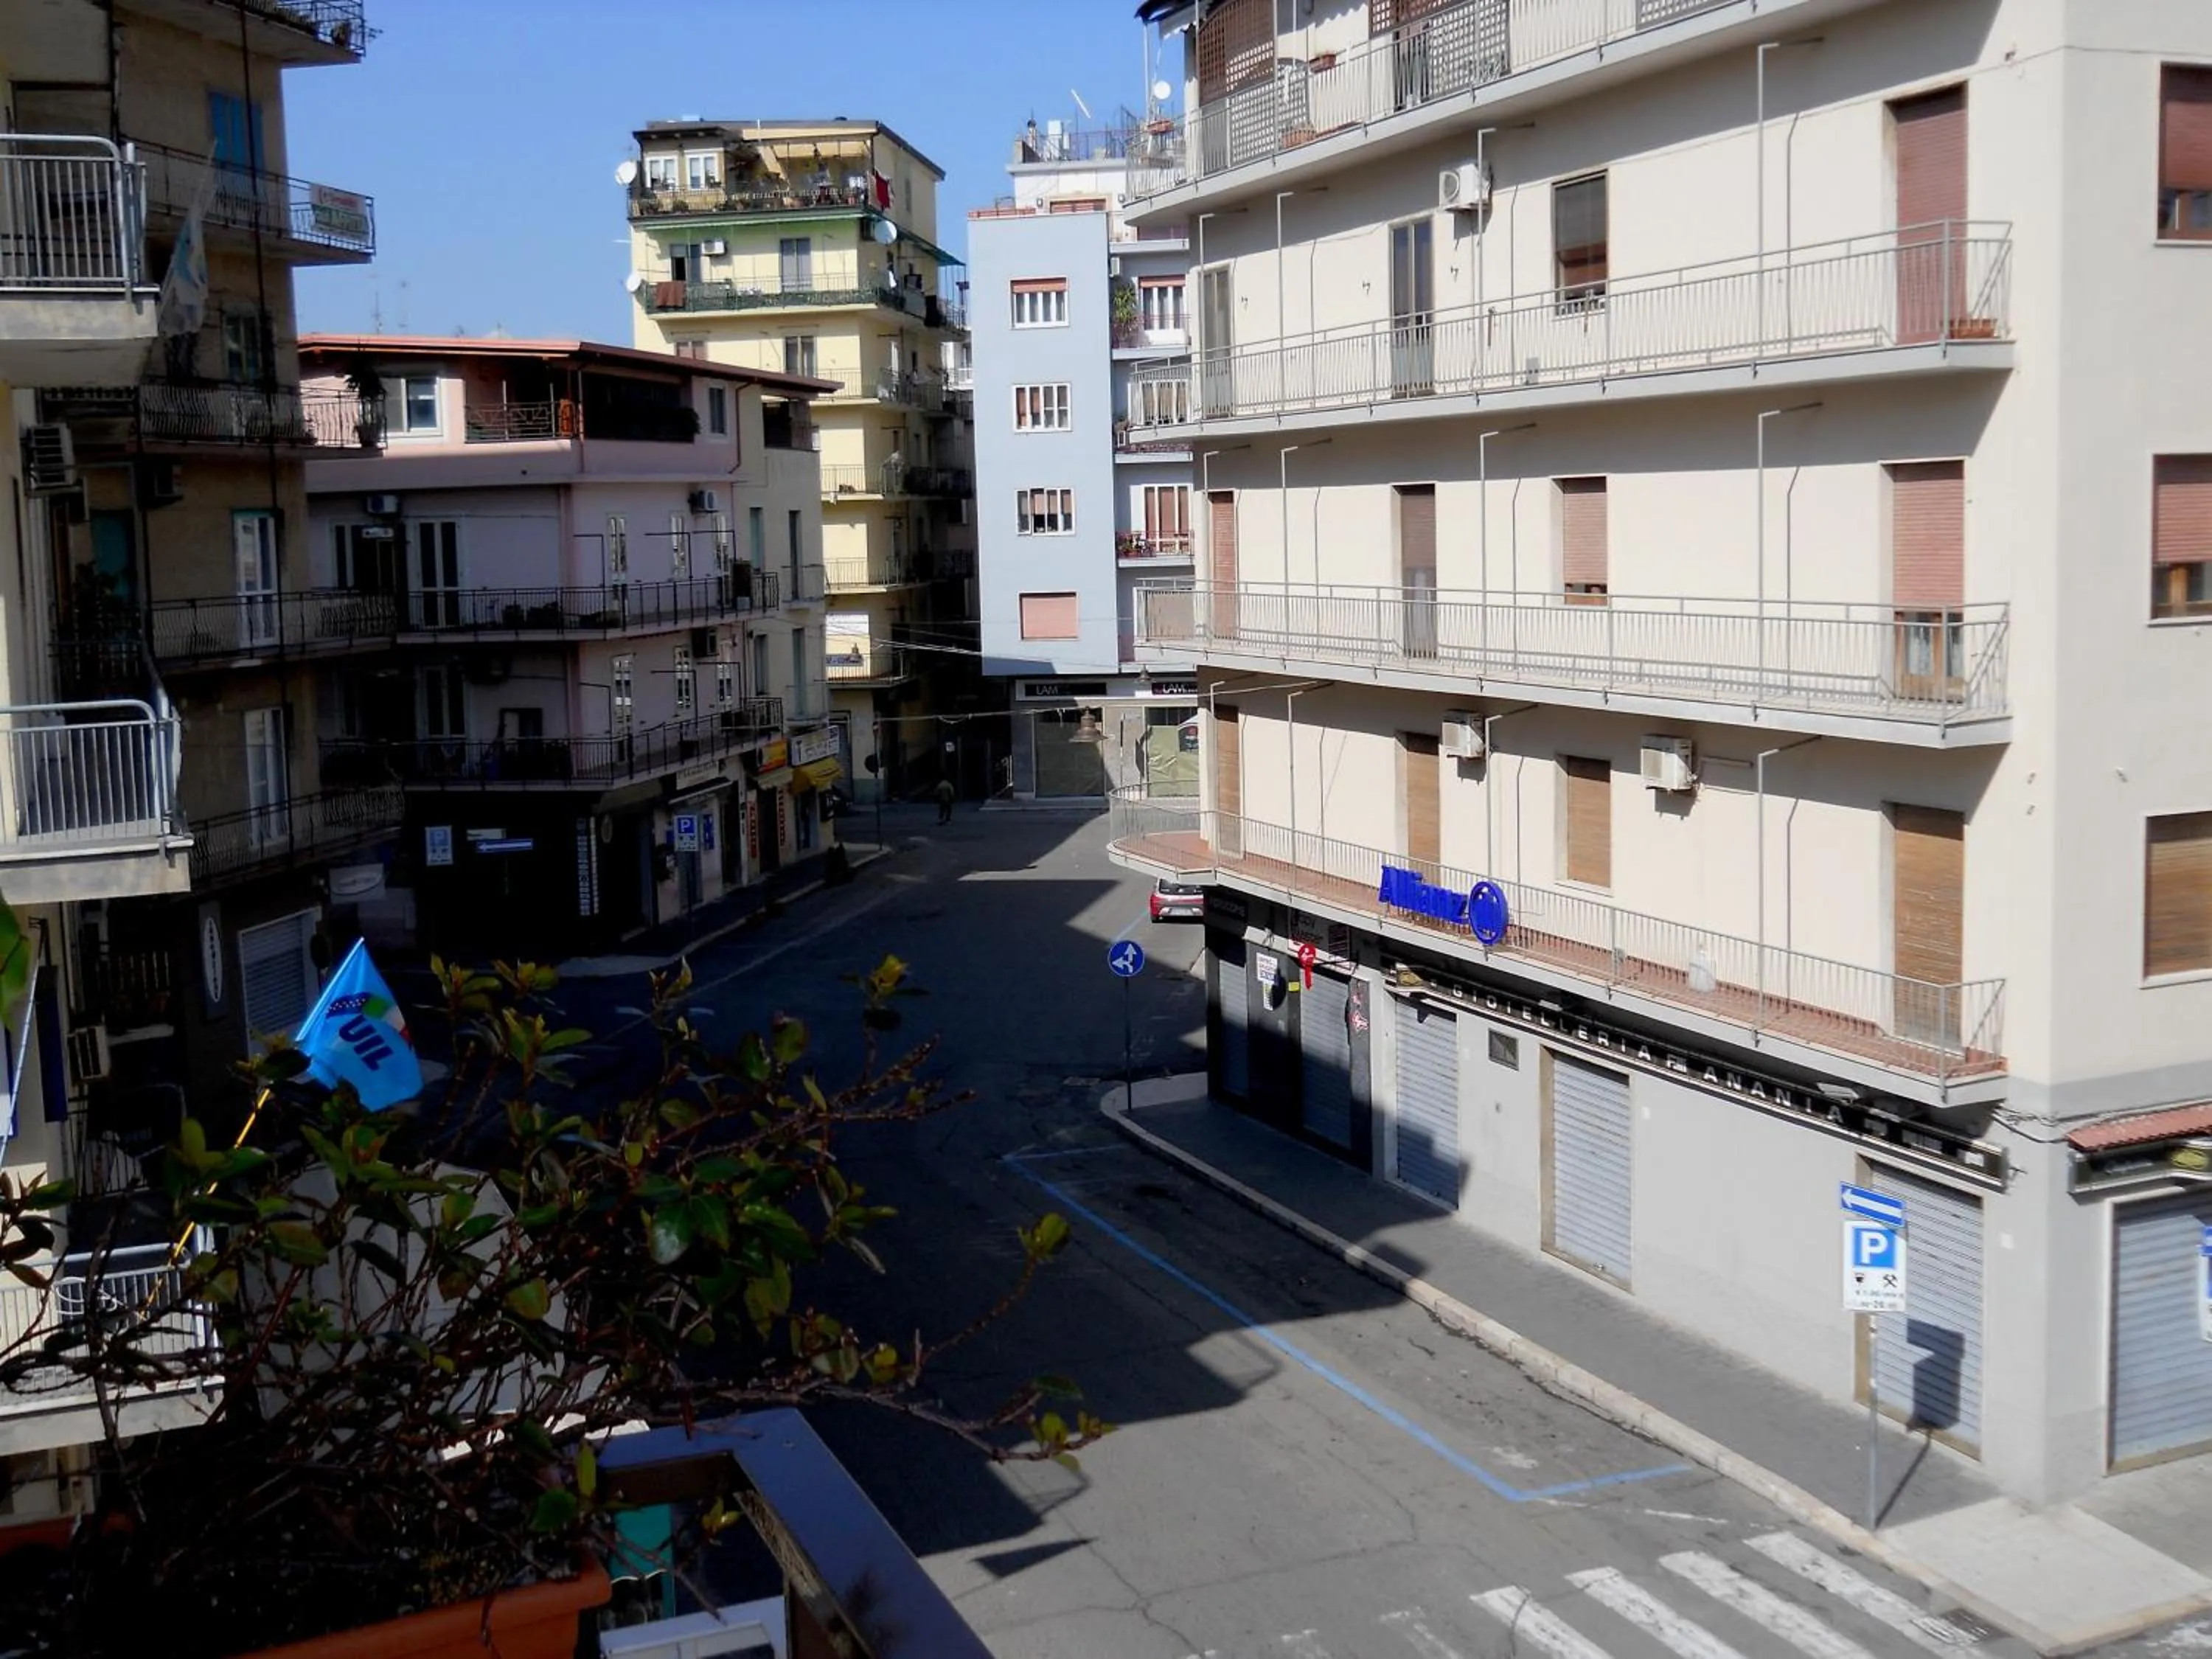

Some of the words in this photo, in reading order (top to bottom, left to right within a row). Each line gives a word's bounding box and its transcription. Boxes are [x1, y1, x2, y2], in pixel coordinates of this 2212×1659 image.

[681, 818, 691, 832] P
[1379, 865, 1470, 925] Allianz
[339, 1014, 394, 1071] UIL
[1450, 984, 1652, 1060] GIOIELLERIA
[1703, 1065, 1843, 1124] ANANIA
[1860, 1231, 1888, 1264] P
